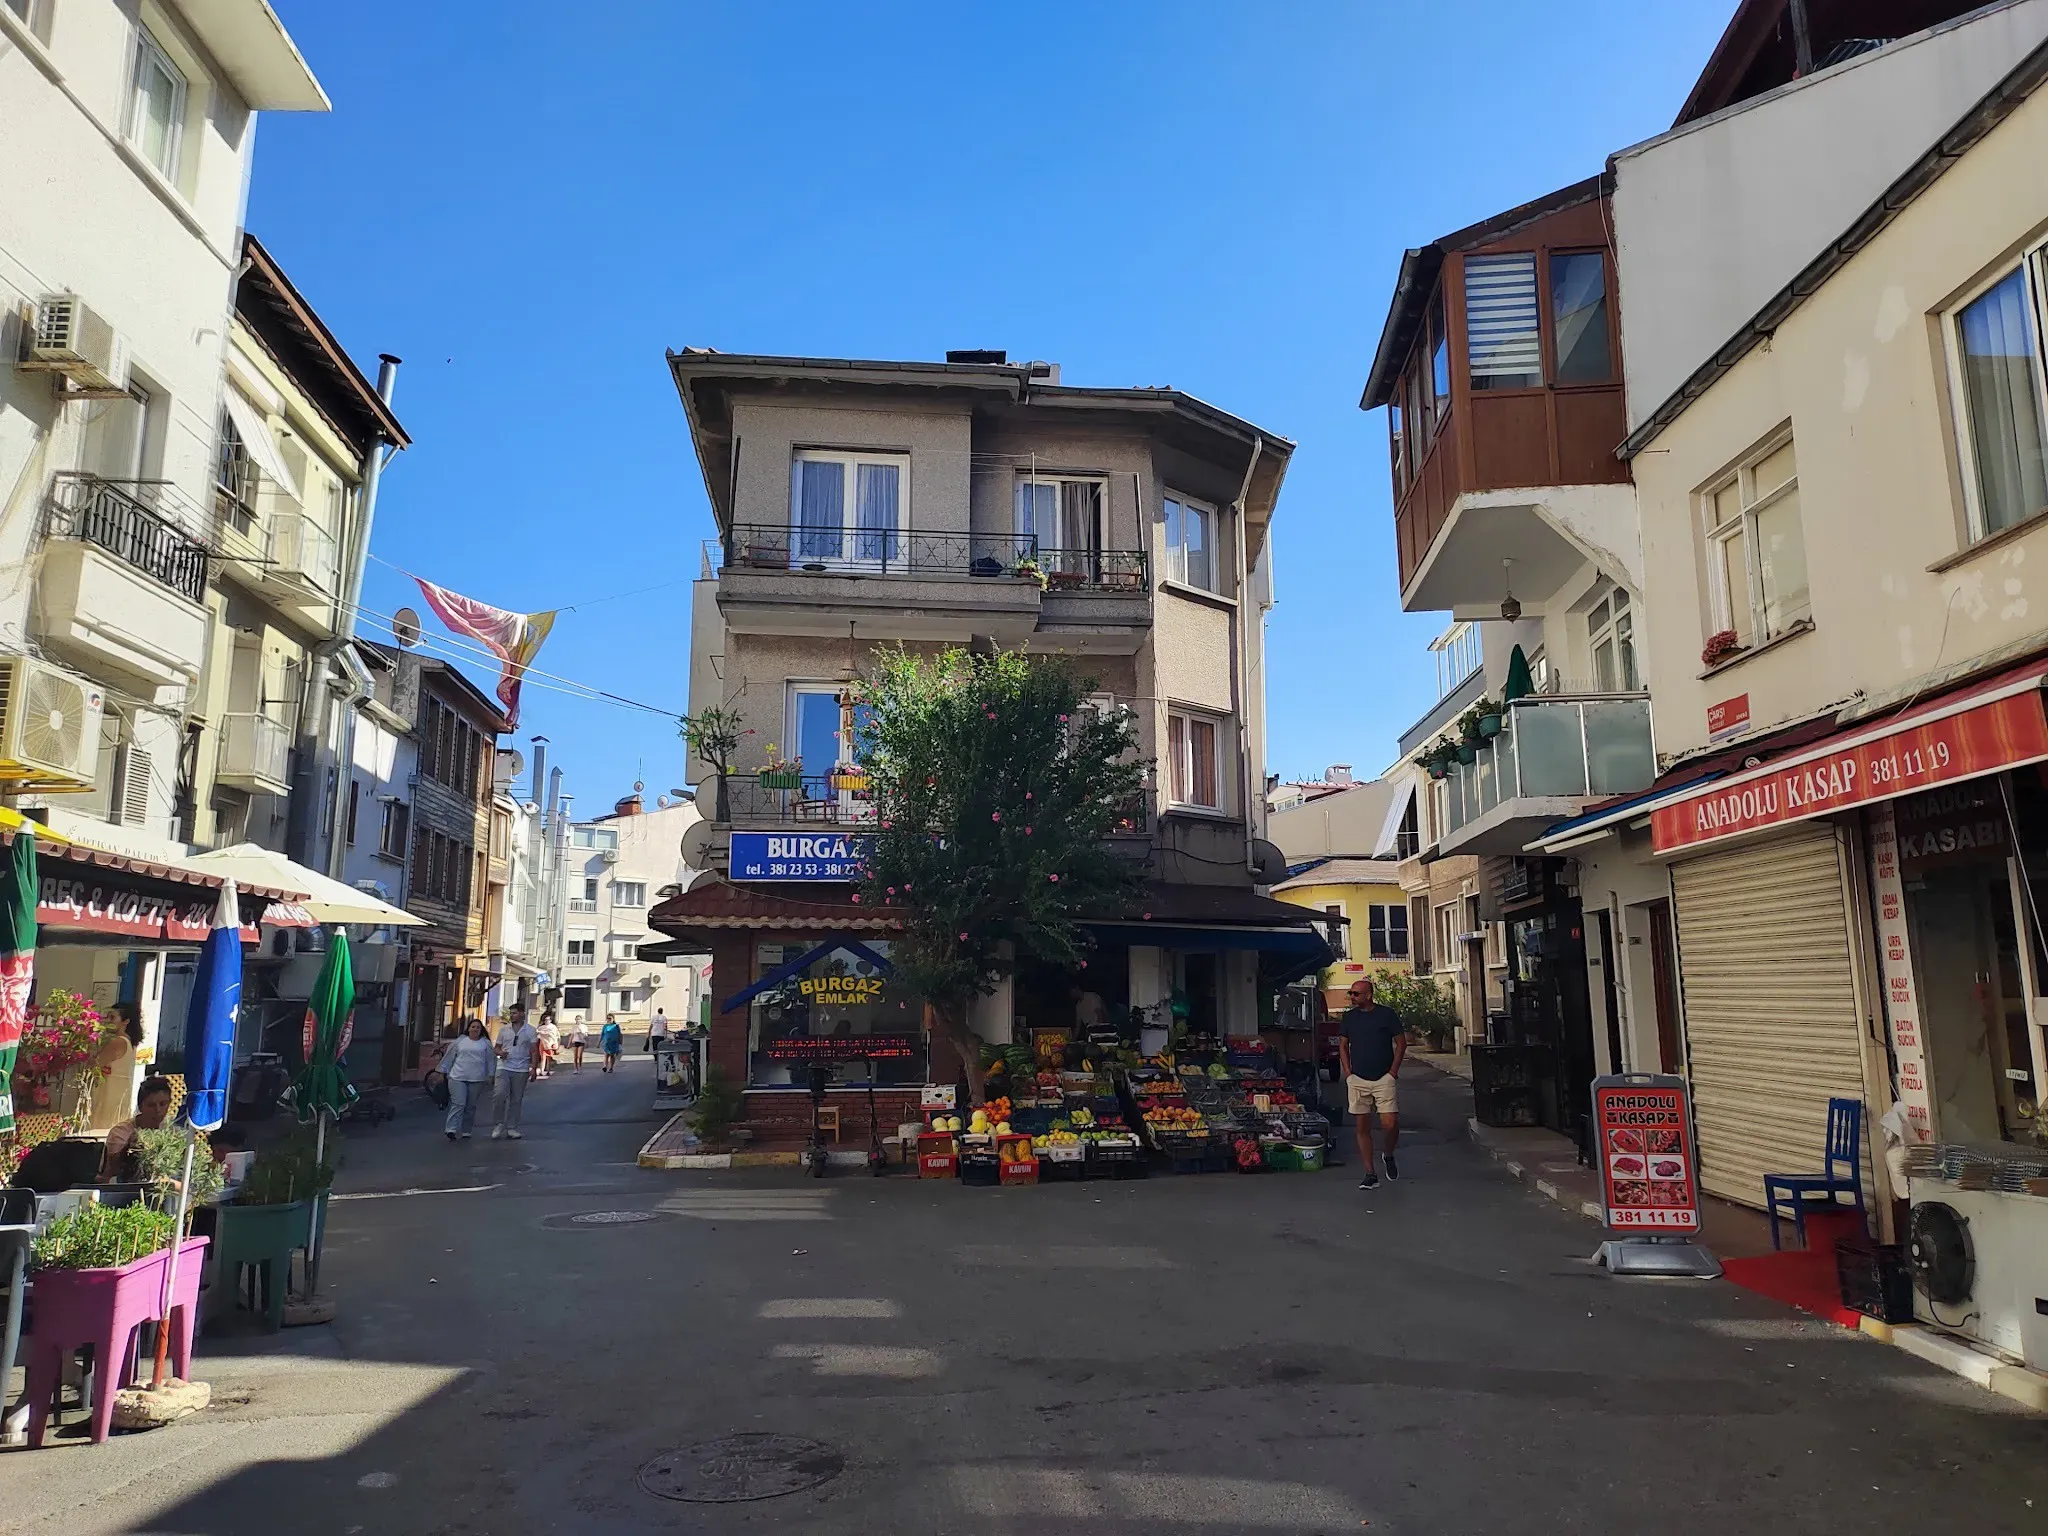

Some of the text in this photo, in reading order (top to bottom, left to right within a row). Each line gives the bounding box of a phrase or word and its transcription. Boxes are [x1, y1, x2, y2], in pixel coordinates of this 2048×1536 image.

[1697, 742, 1950, 831] ANADOLU KASAP 381 11 19
[1899, 820, 2004, 859] KASABI
[767, 838, 865, 858] BURGAZ
[746, 864, 765, 875] tel.
[770, 864, 786, 875] 381
[790, 864, 802, 875] 23
[38, 876, 85, 920] REÇ
[88, 887, 102, 918] &
[1882, 894, 1898, 905] ADANA
[1884, 908, 1898, 920] KEBAP
[1888, 950, 1904, 960] KEBAP
[800, 976, 883, 995] BURGAZ
[1891, 978, 1908, 989] KASAP
[815, 993, 868, 1004] EMLAK
[1892, 992, 1910, 1002] SUCUK
[1896, 1020, 1914, 1032] BATON
[1897, 1034, 1916, 1047] SUCUK
[1903, 1062, 1918, 1074] KUZU
[1900, 1076, 1923, 1091] PİRZOLA
[1605, 1096, 1676, 1110] ANADOLU
[1619, 1112, 1666, 1124] KASAP
[928, 1158, 950, 1168] KAVUN
[1008, 1164, 1032, 1174] KAVUN
[1616, 1211, 1691, 1224] 381 11 19
